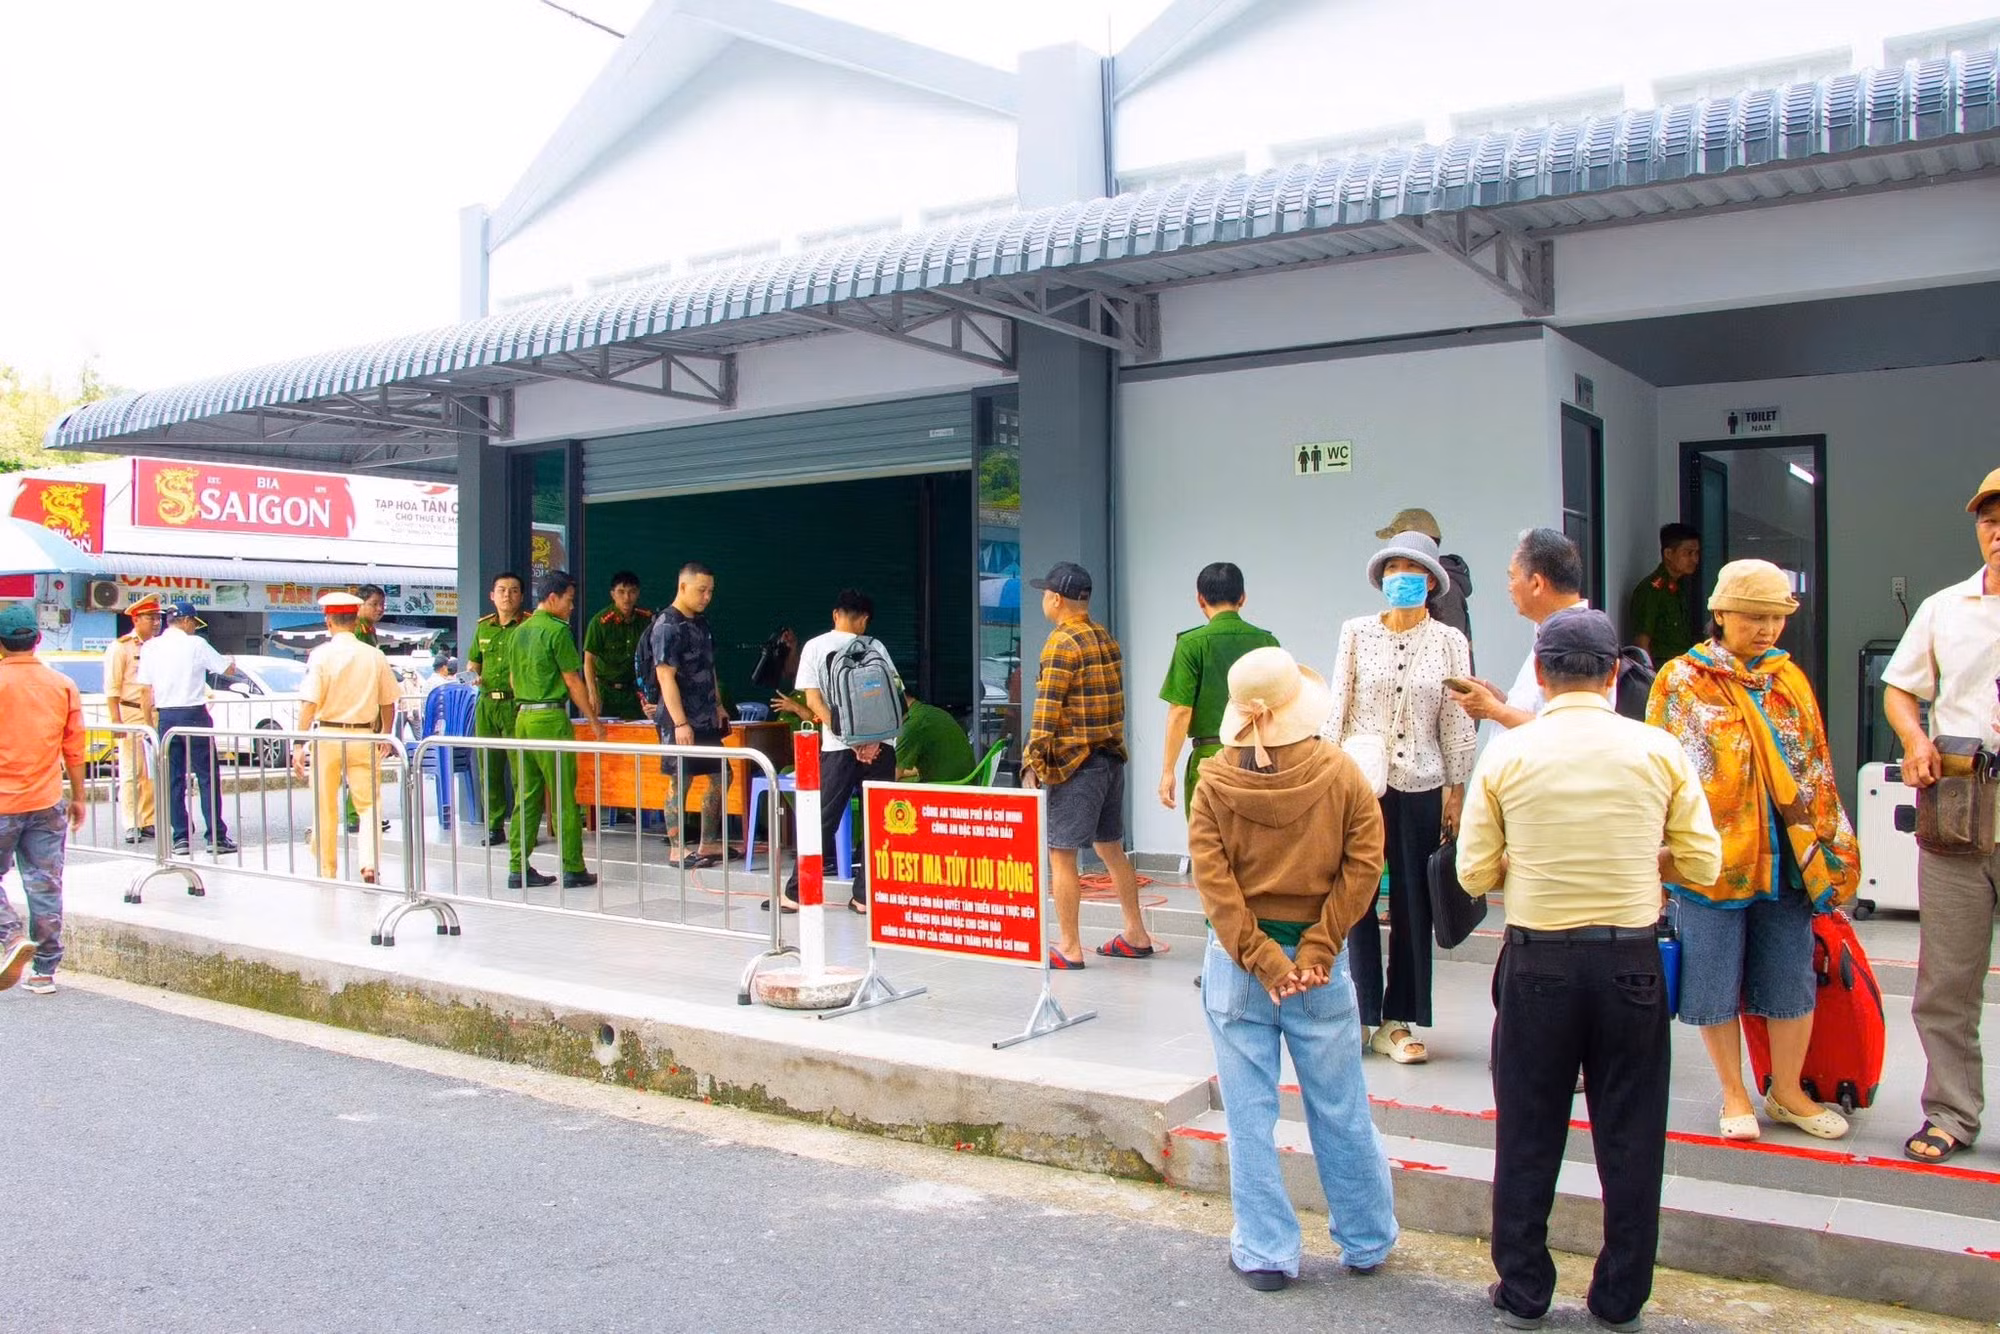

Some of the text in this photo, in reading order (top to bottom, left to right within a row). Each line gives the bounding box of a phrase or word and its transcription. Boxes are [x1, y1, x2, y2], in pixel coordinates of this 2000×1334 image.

[1745, 411, 1776, 422] TOILET
[1328, 446, 1348, 459] WC
[257, 477, 280, 490] BIA
[200, 489, 330, 528] SAIGON
[265, 582, 313, 605] TÂN
[922, 804, 938, 817] CÔNG
[939, 807, 948, 818] AN
[949, 806, 969, 819] THÀNH
[970, 807, 982, 820] PHỐ
[994, 809, 1004, 821] CHÍ
[932, 821, 948, 834] CÔNG
[949, 824, 958, 834] AN
[972, 826, 984, 836] KHU
[875, 840, 1033, 899] TỔ TEST MA TÚY LƯU ĐỘNG
